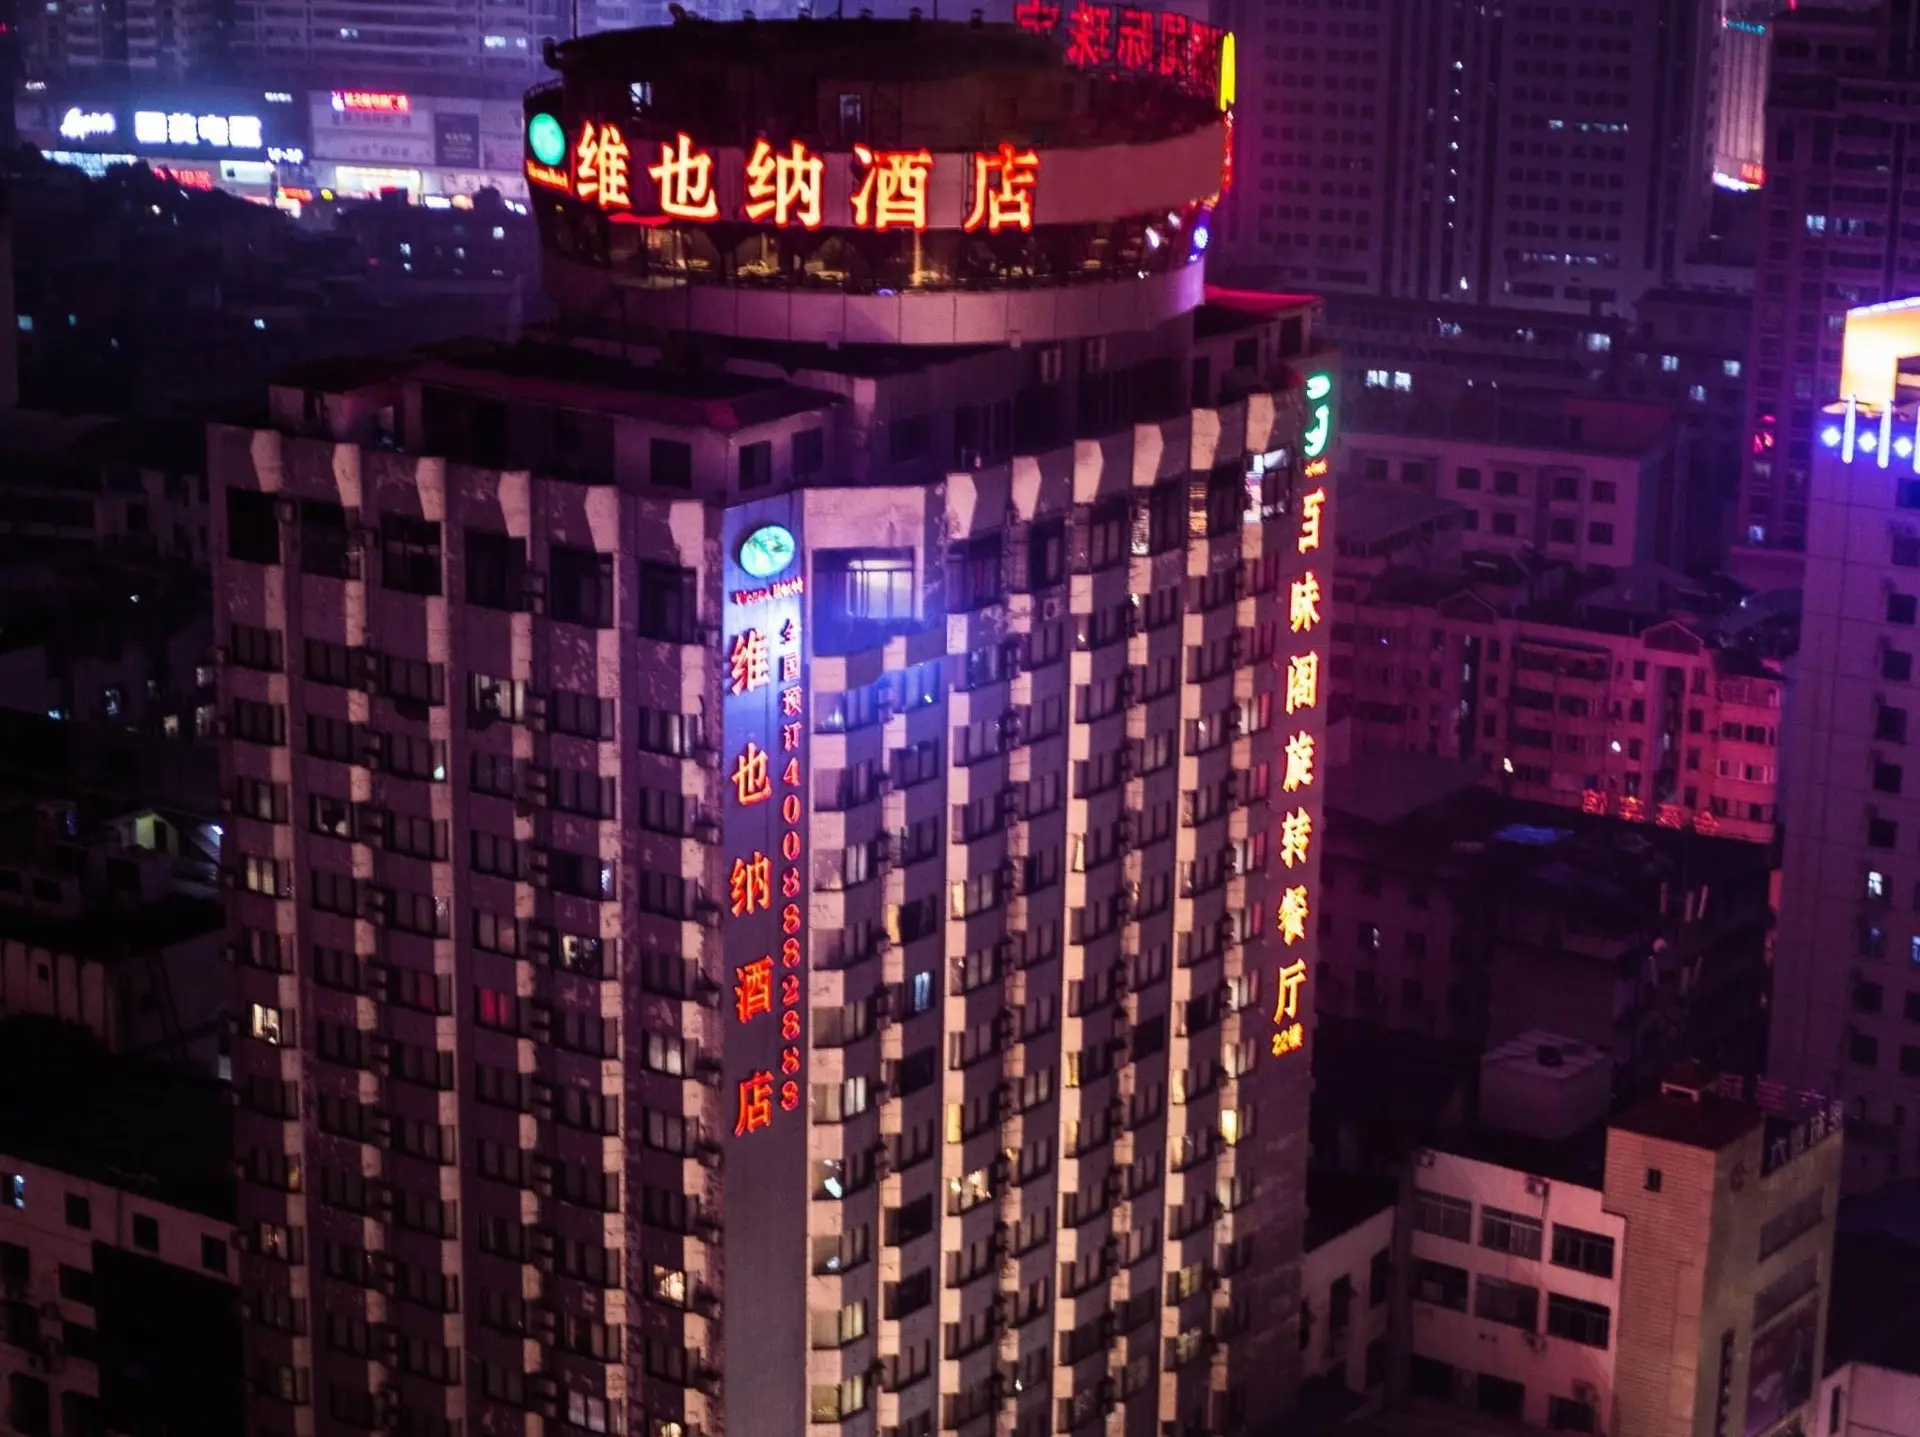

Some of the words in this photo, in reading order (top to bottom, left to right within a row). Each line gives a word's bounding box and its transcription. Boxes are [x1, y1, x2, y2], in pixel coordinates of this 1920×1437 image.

[575, 118, 1042, 231] 维也纳酒店
[730, 627, 774, 1138] 维也纳酒店
[1272, 487, 1325, 1025] 百味阁旋转餐厅
